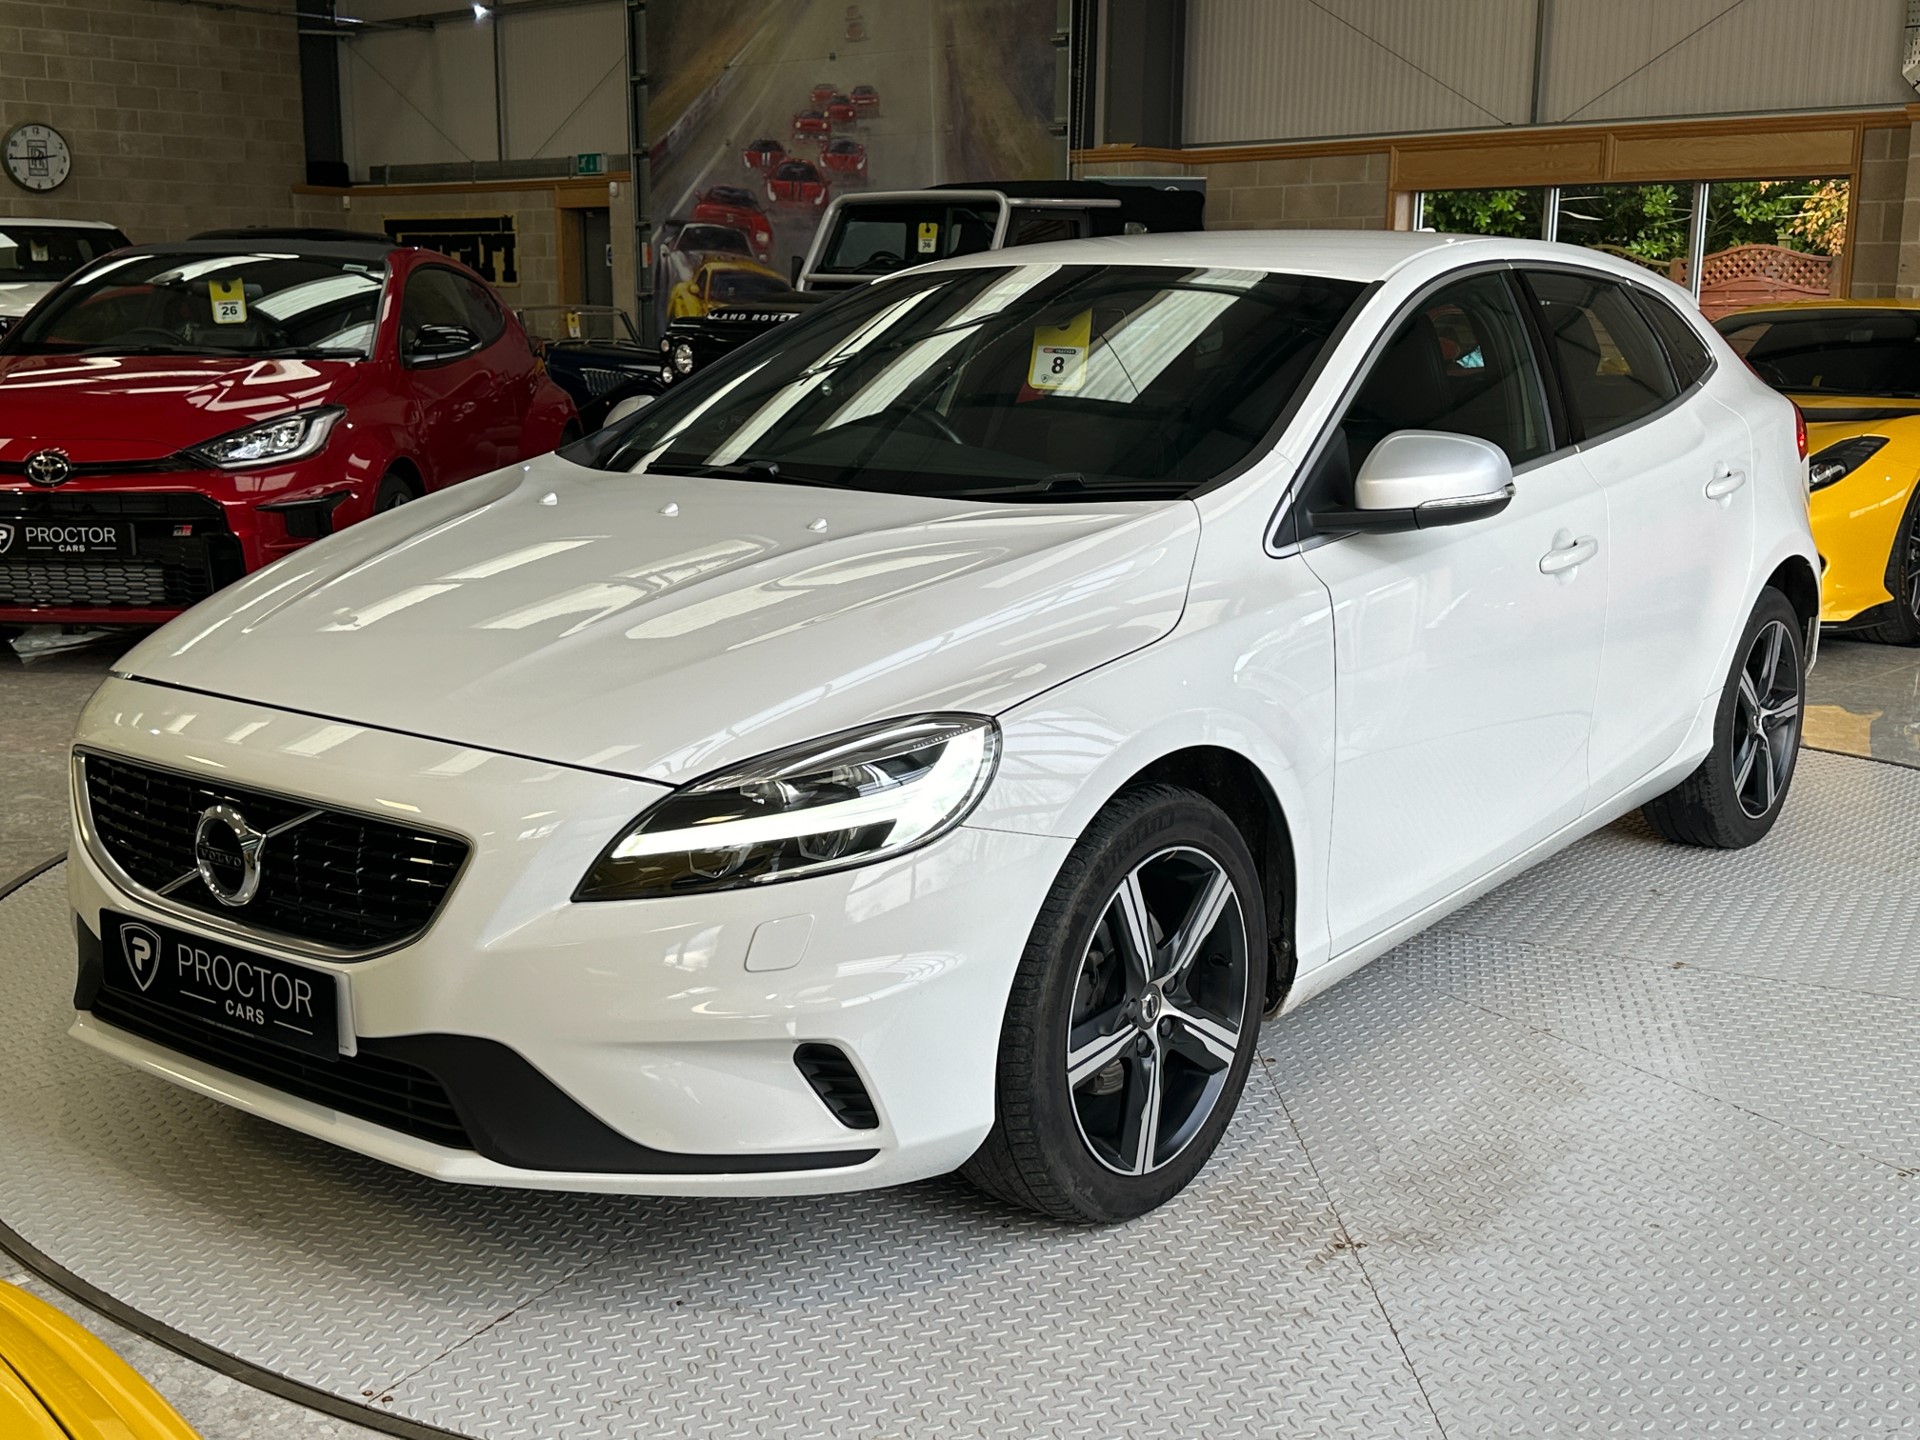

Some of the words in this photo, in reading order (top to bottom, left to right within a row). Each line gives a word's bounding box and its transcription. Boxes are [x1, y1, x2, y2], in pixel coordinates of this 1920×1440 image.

[221, 305, 238, 316] 26
[711, 312, 747, 321] LAND
[1051, 356, 1065, 374] 8
[25, 527, 117, 543] PROCTOR
[58, 544, 86, 552] CARS
[199, 846, 242, 867] VOLVO
[131, 936, 151, 971] P
[177, 943, 314, 1018] PROCTOR
[225, 999, 265, 1025] CARS
